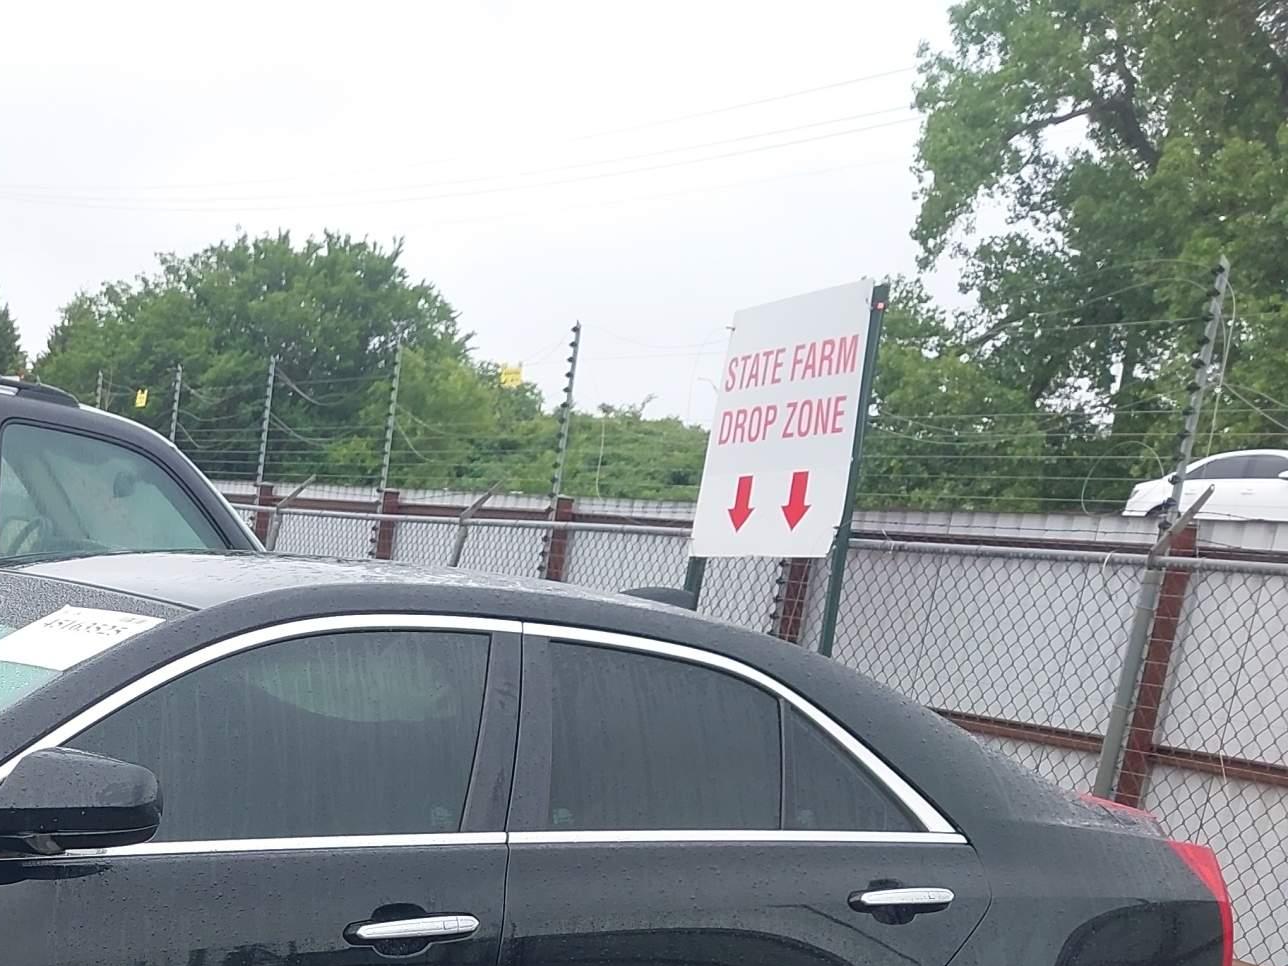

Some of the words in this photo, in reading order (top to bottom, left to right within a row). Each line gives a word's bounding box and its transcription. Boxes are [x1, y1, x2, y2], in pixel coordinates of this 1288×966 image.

[724, 347, 787, 393] STATE
[789, 335, 860, 382] FARM
[718, 405, 777, 446] DROP
[782, 395, 848, 440] ZONE
